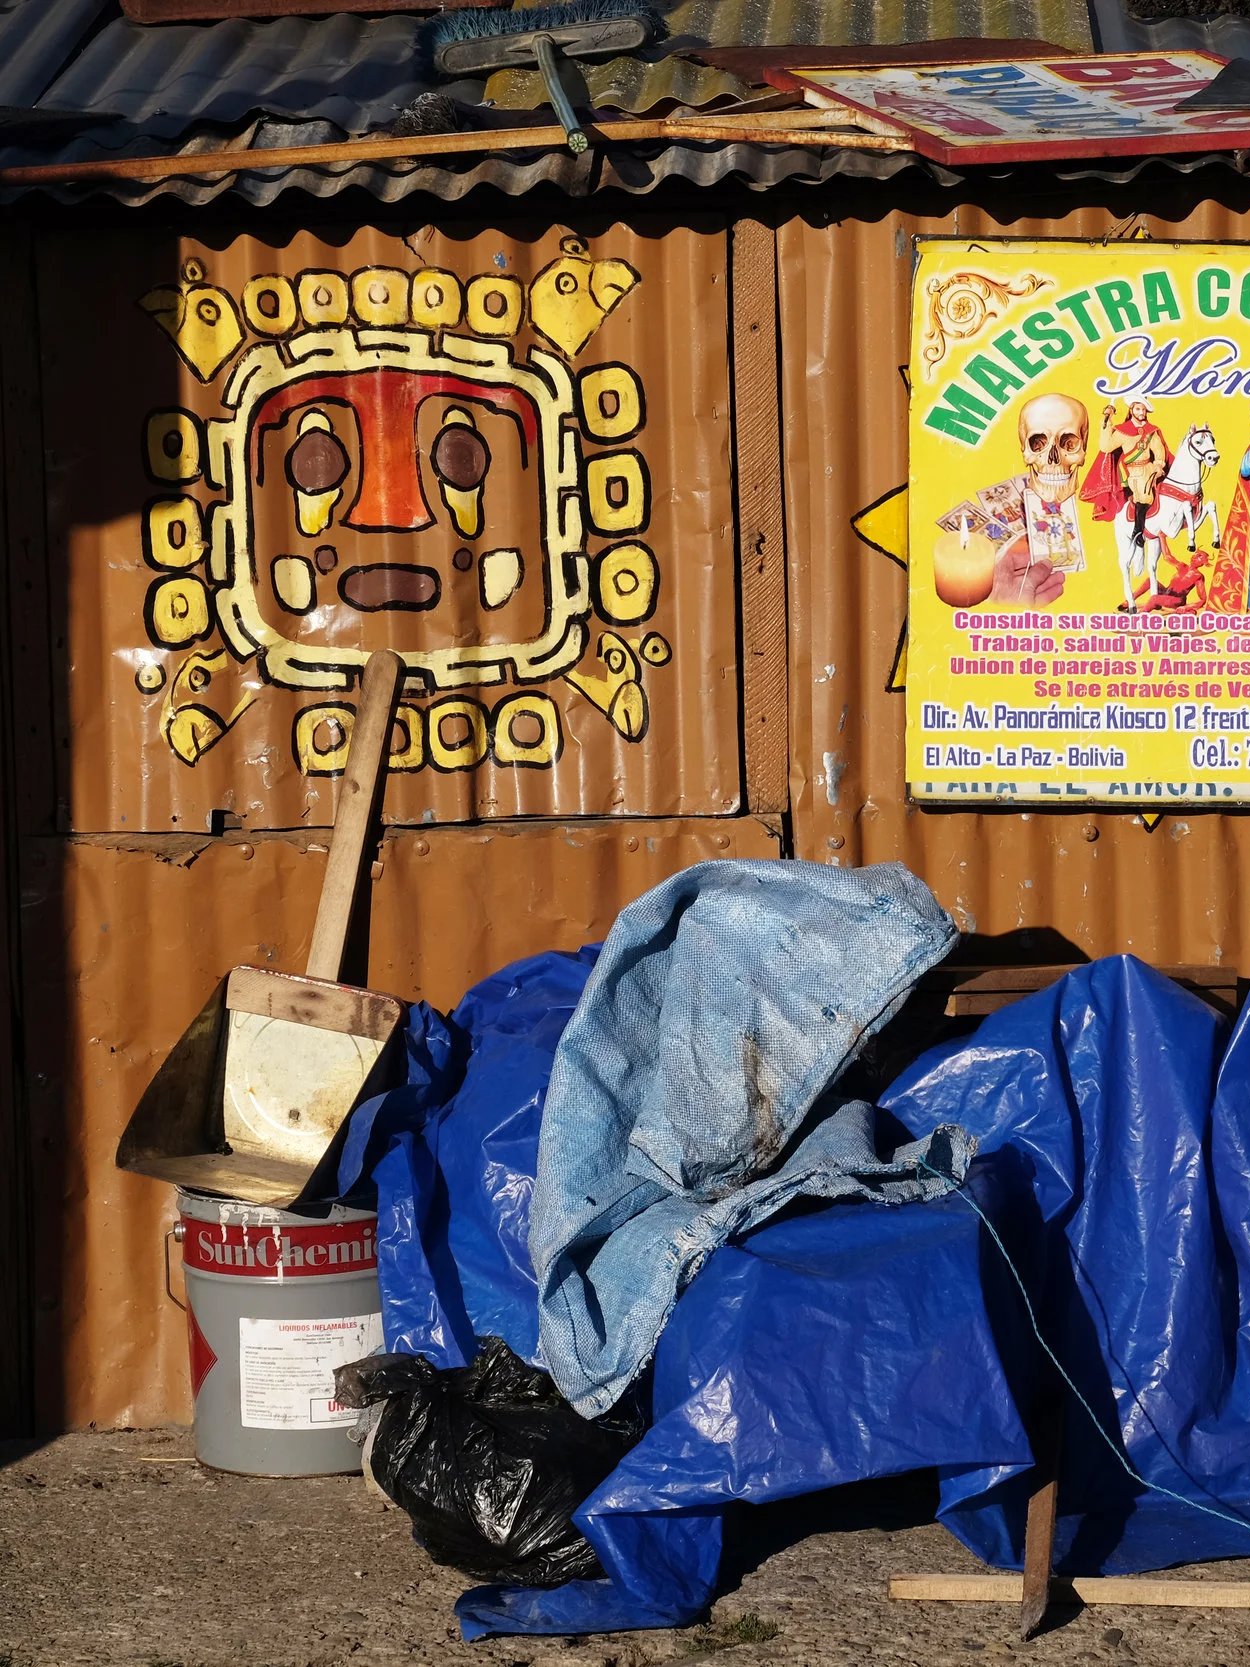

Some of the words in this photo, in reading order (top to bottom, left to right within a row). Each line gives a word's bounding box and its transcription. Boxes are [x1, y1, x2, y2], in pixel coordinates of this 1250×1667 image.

[918, 66, 1172, 136] PUBLICO
[925, 271, 1181, 446] MAESTRA
[954, 611, 1053, 630] Consulta
[1058, 615, 1085, 630] su
[1090, 613, 1164, 631] suerte
[1167, 616, 1196, 631] en
[969, 634, 1059, 654] Trabajo,
[1063, 635, 1126, 653] salud
[1130, 638, 1143, 655] y
[1147, 635, 1222, 655] Viajes,
[951, 657, 1015, 675] Union
[1019, 657, 1047, 675] de
[1052, 658, 1137, 677] parejas
[1142, 661, 1155, 677] y
[1035, 680, 1061, 697] Se
[1067, 680, 1101, 697] lee
[1107, 680, 1190, 698] através
[1195, 681, 1222, 697] de
[923, 704, 957, 729] Dir.:
[963, 705, 989, 729] Av.
[994, 704, 1101, 729] Panorámica
[1106, 705, 1166, 729] Kiosco
[1175, 705, 1196, 729] 12
[926, 747, 940, 766] El
[947, 747, 981, 766] Alto
[997, 747, 1017, 767] La
[1021, 747, 1051, 767] Paz
[1068, 747, 1124, 767] Bolivia
[1192, 738, 1239, 767] Cel.:
[198, 1228, 378, 1268] SunChemi
[312, 1321, 358, 1332] INFLAMABLES
